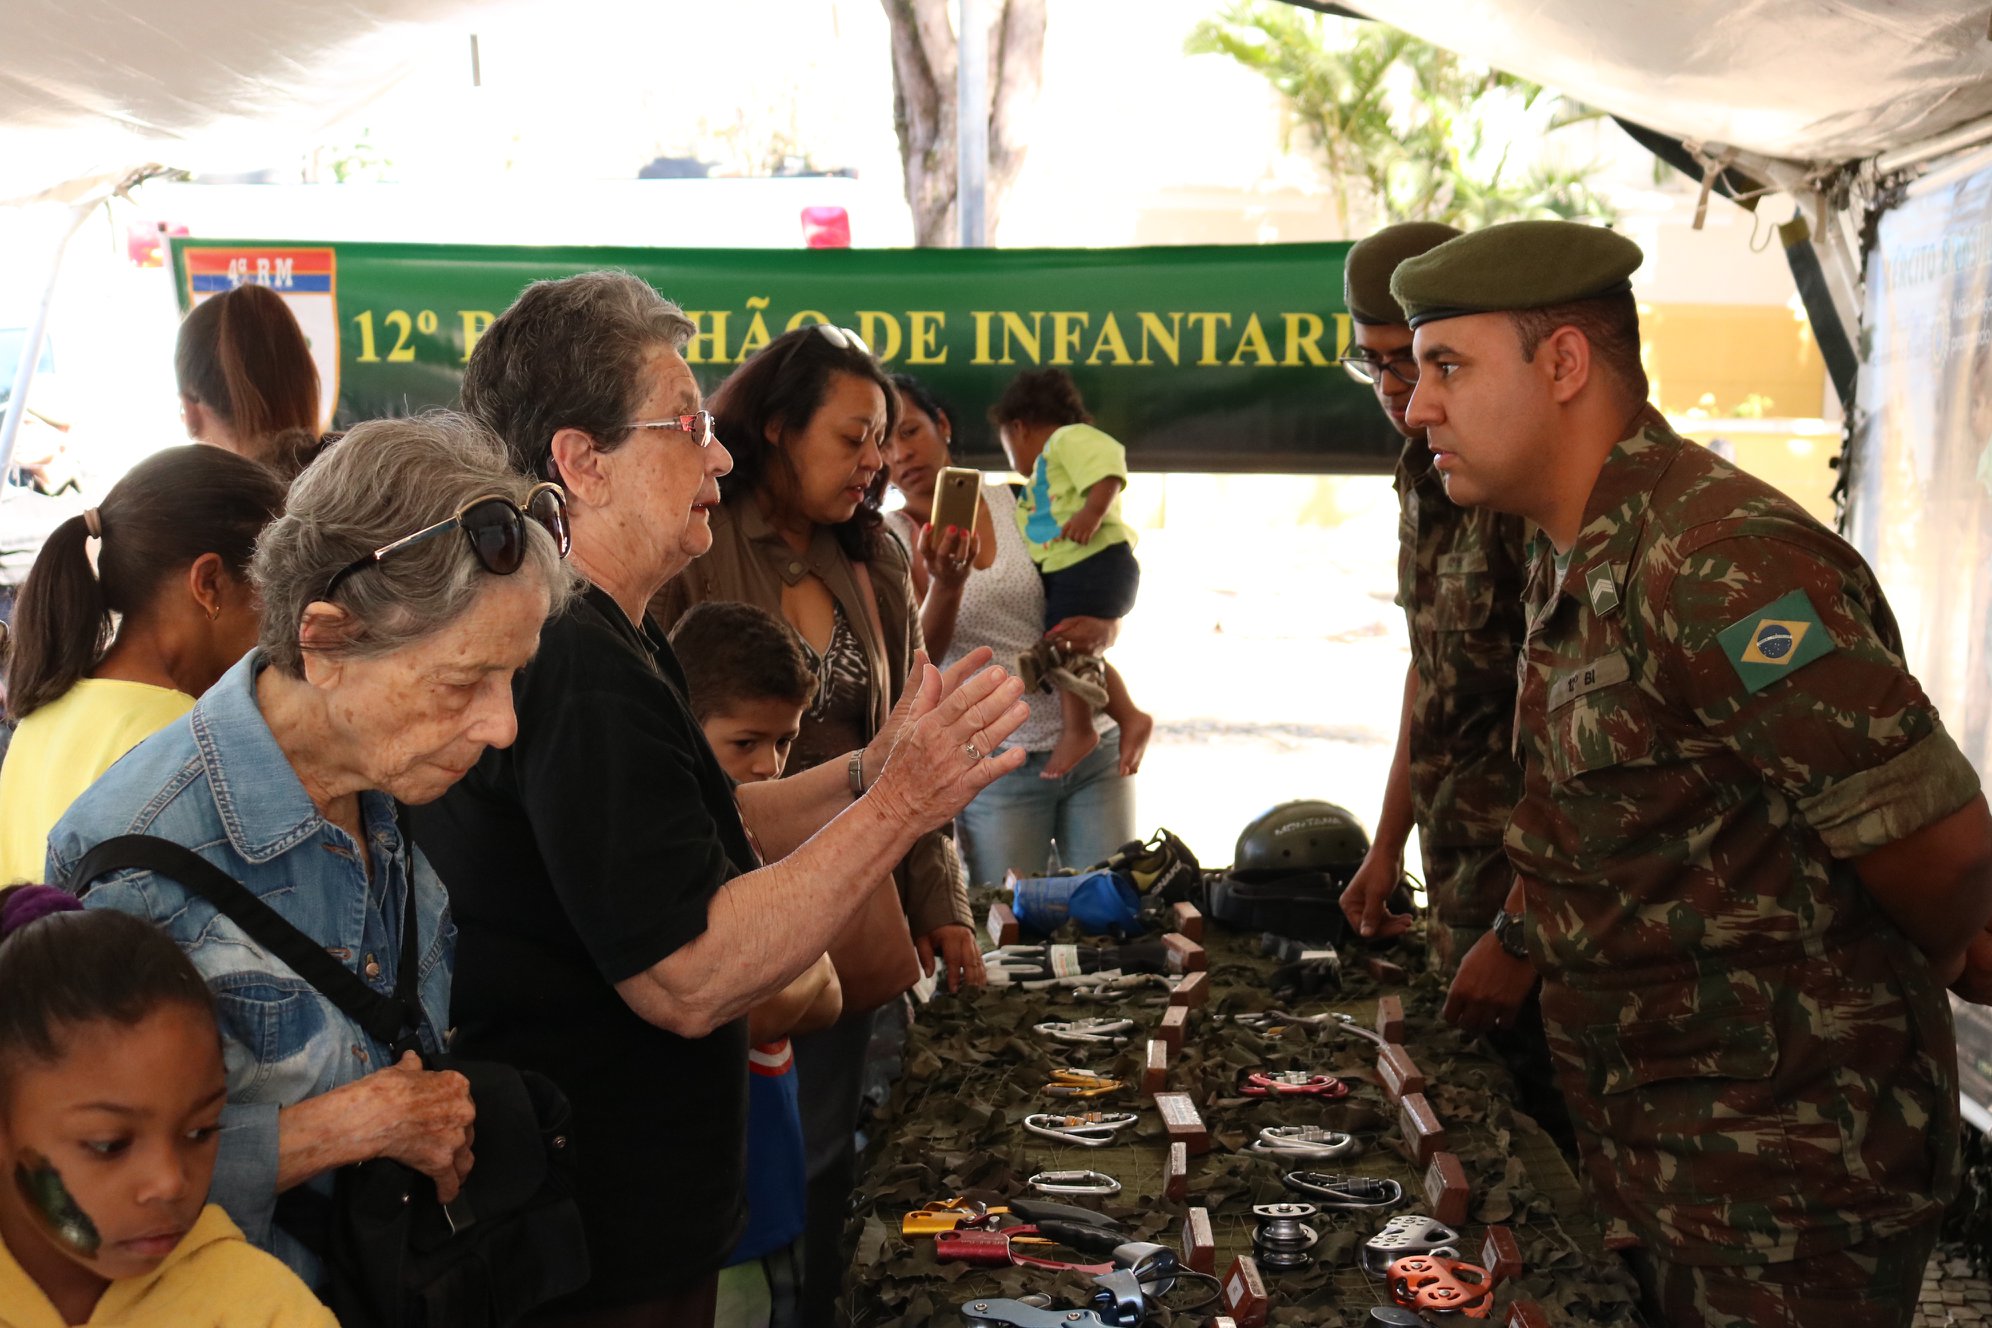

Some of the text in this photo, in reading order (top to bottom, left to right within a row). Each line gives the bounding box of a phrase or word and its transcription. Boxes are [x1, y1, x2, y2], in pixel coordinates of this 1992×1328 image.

[256, 257, 294, 288] RM
[353, 309, 438, 363] 12º
[855, 310, 948, 365] DE
[969, 311, 1353, 367] INFANTARI
